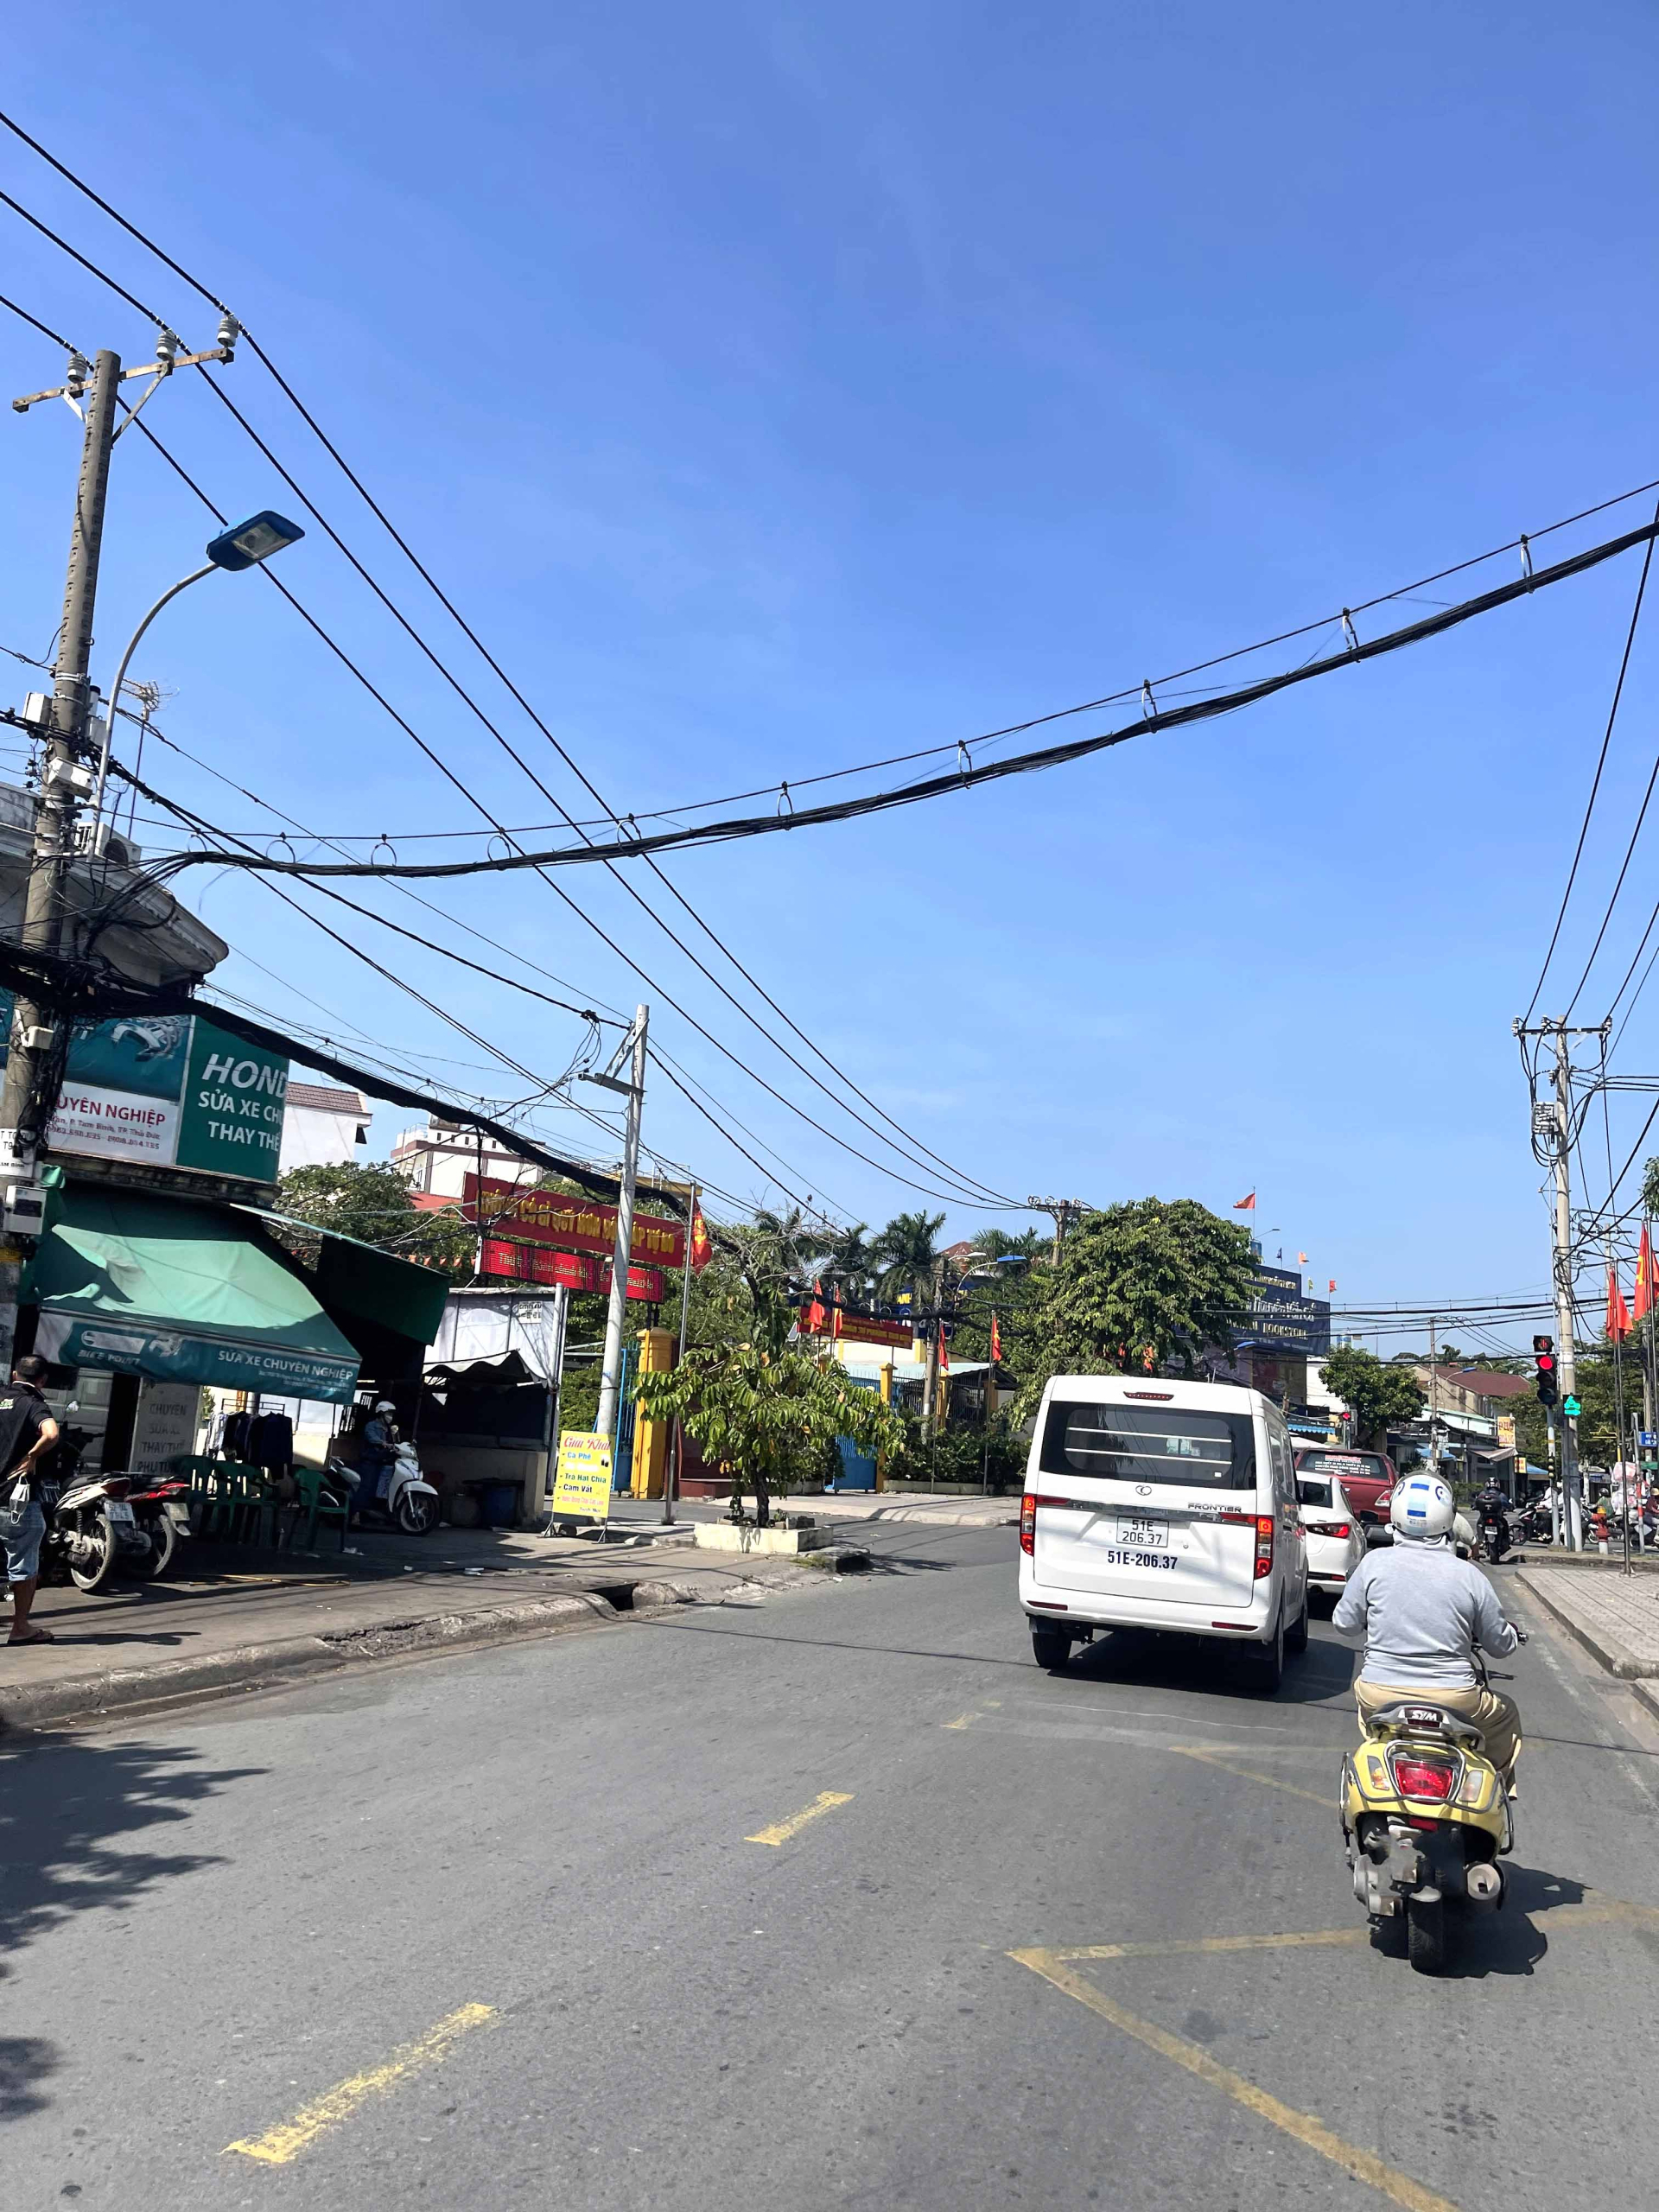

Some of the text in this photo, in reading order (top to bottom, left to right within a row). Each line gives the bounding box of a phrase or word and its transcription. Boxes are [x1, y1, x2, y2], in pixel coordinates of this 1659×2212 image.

[56, 1096, 166, 1128] UYÊN NGHIỆP
[198, 1089, 235, 1114] SỬA
[239, 1099, 260, 1118] XE
[208, 1121, 256, 1145] THAY
[245, 1355, 261, 1366] XE
[263, 1357, 309, 1374] CHUYÊN
[311, 1366, 353, 1382] NGHIỆP
[1188, 1503, 1243, 1513] FRONTIER
[1132, 1519, 1154, 1532] 51E
[1122, 1531, 1162, 1545] 206.37
[1108, 1550, 1178, 1570] 51E-206.37
[1411, 1710, 1437, 1721] SYM
